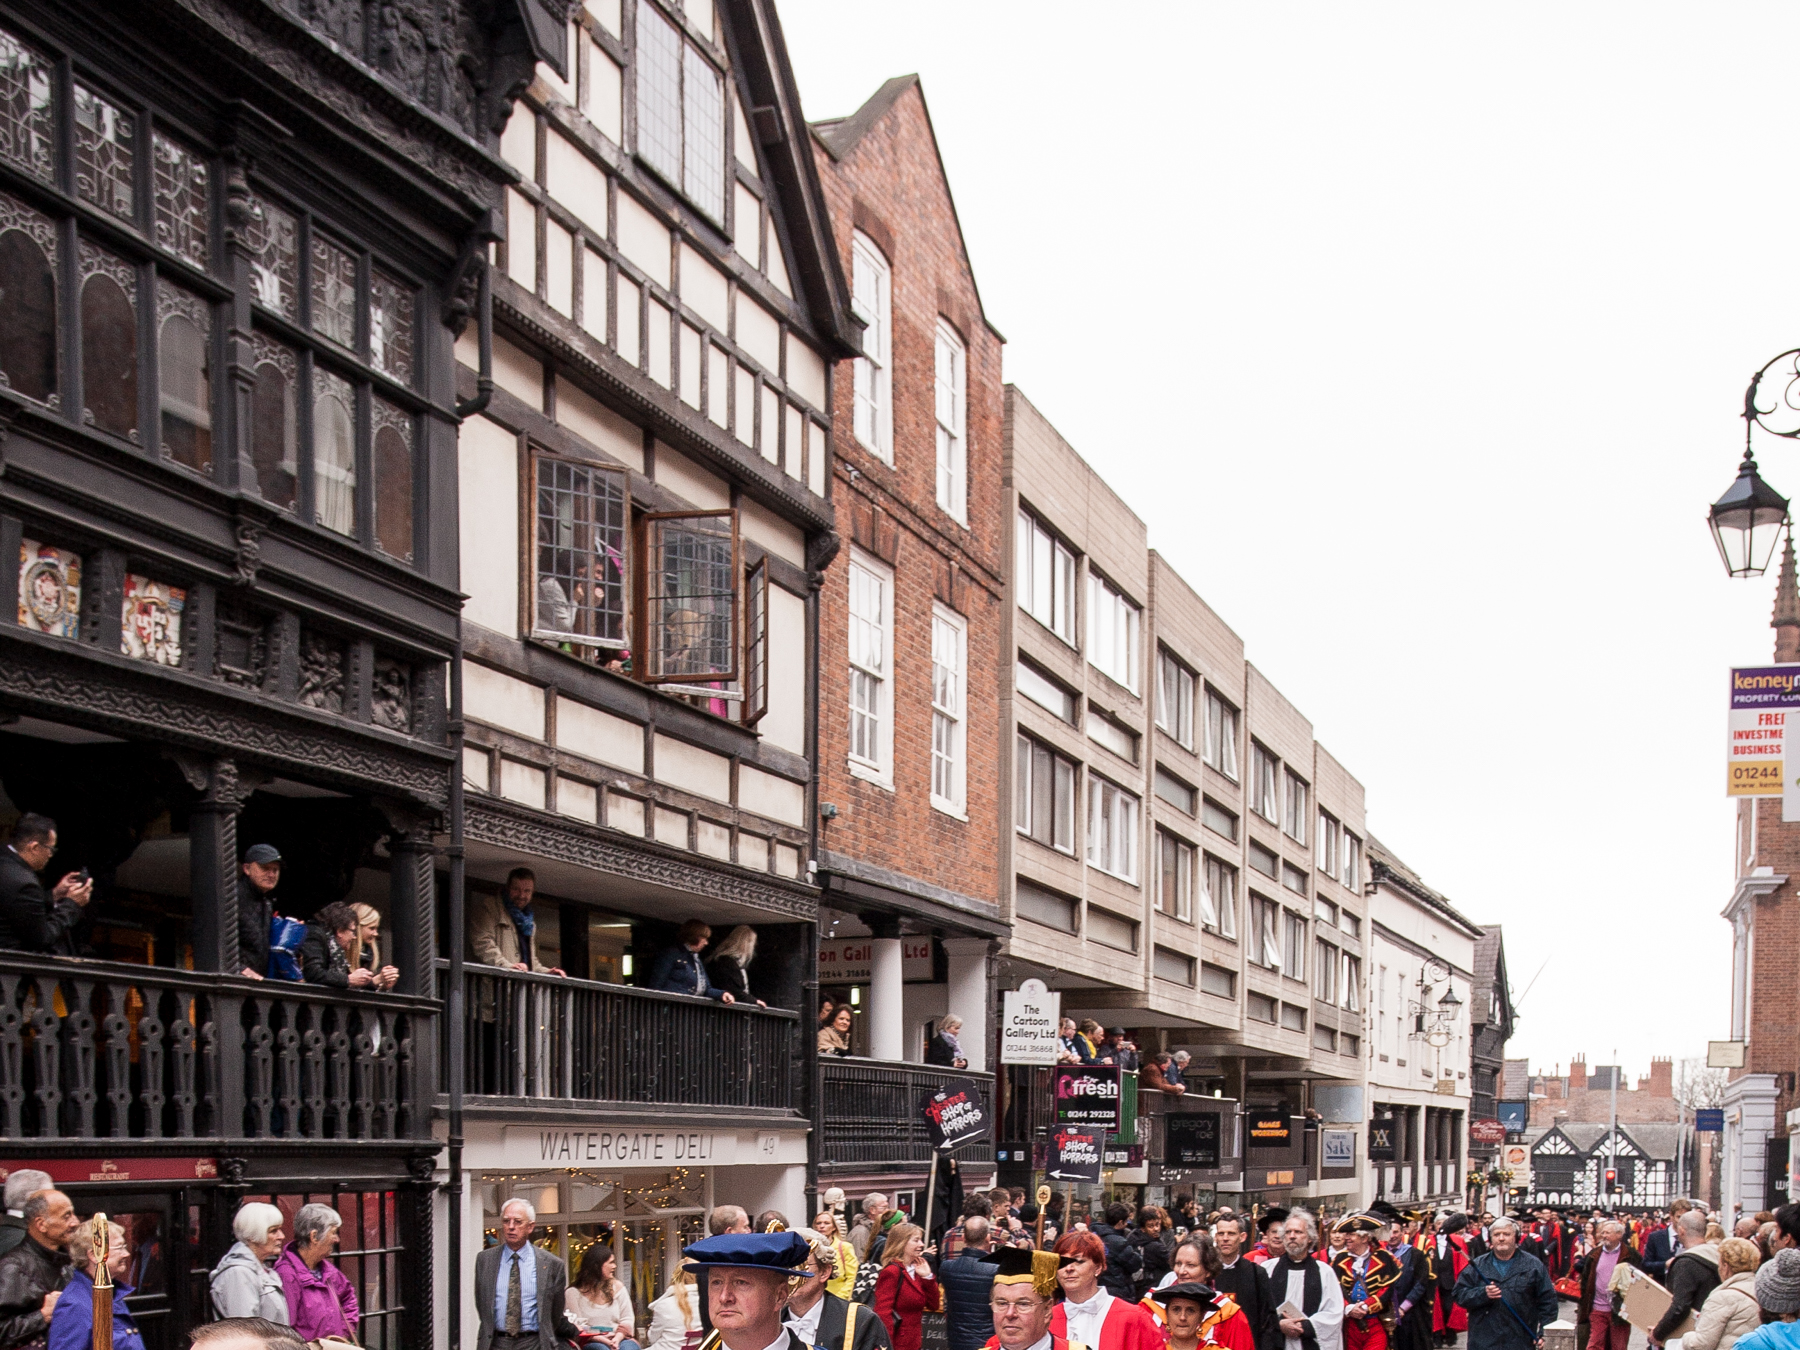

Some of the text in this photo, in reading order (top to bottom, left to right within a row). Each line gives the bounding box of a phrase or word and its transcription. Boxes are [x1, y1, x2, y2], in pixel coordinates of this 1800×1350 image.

[1733, 694, 1779, 704] PROPERTY
[1733, 744, 1782, 755] BUSINESS
[1733, 767, 1779, 779] 01244
[904, 943, 929, 959] Ltd
[1023, 1004, 1040, 1015] The
[1012, 1015, 1050, 1026] Cartoon
[1005, 1027, 1056, 1040] Gallery Ltd
[1006, 1044, 1054, 1053] 01244 316868
[1072, 1079, 1118, 1096] fresh
[940, 1101, 965, 1120] SHOP
[1067, 1110, 1088, 1118] 01244
[940, 1108, 983, 1137] HORRORS
[1170, 1119, 1215, 1131] gregory
[1250, 1129, 1289, 1139] WORKSHOP
[1472, 1132, 1503, 1140] TATTOO
[540, 1131, 715, 1161] WATERGATE DELI
[762, 1137, 775, 1155] 49
[1065, 1140, 1088, 1152] SHOP
[1325, 1140, 1352, 1155] Saks
[1060, 1149, 1099, 1165] HORRORS
[89, 1172, 130, 1181] RESTAURANT
